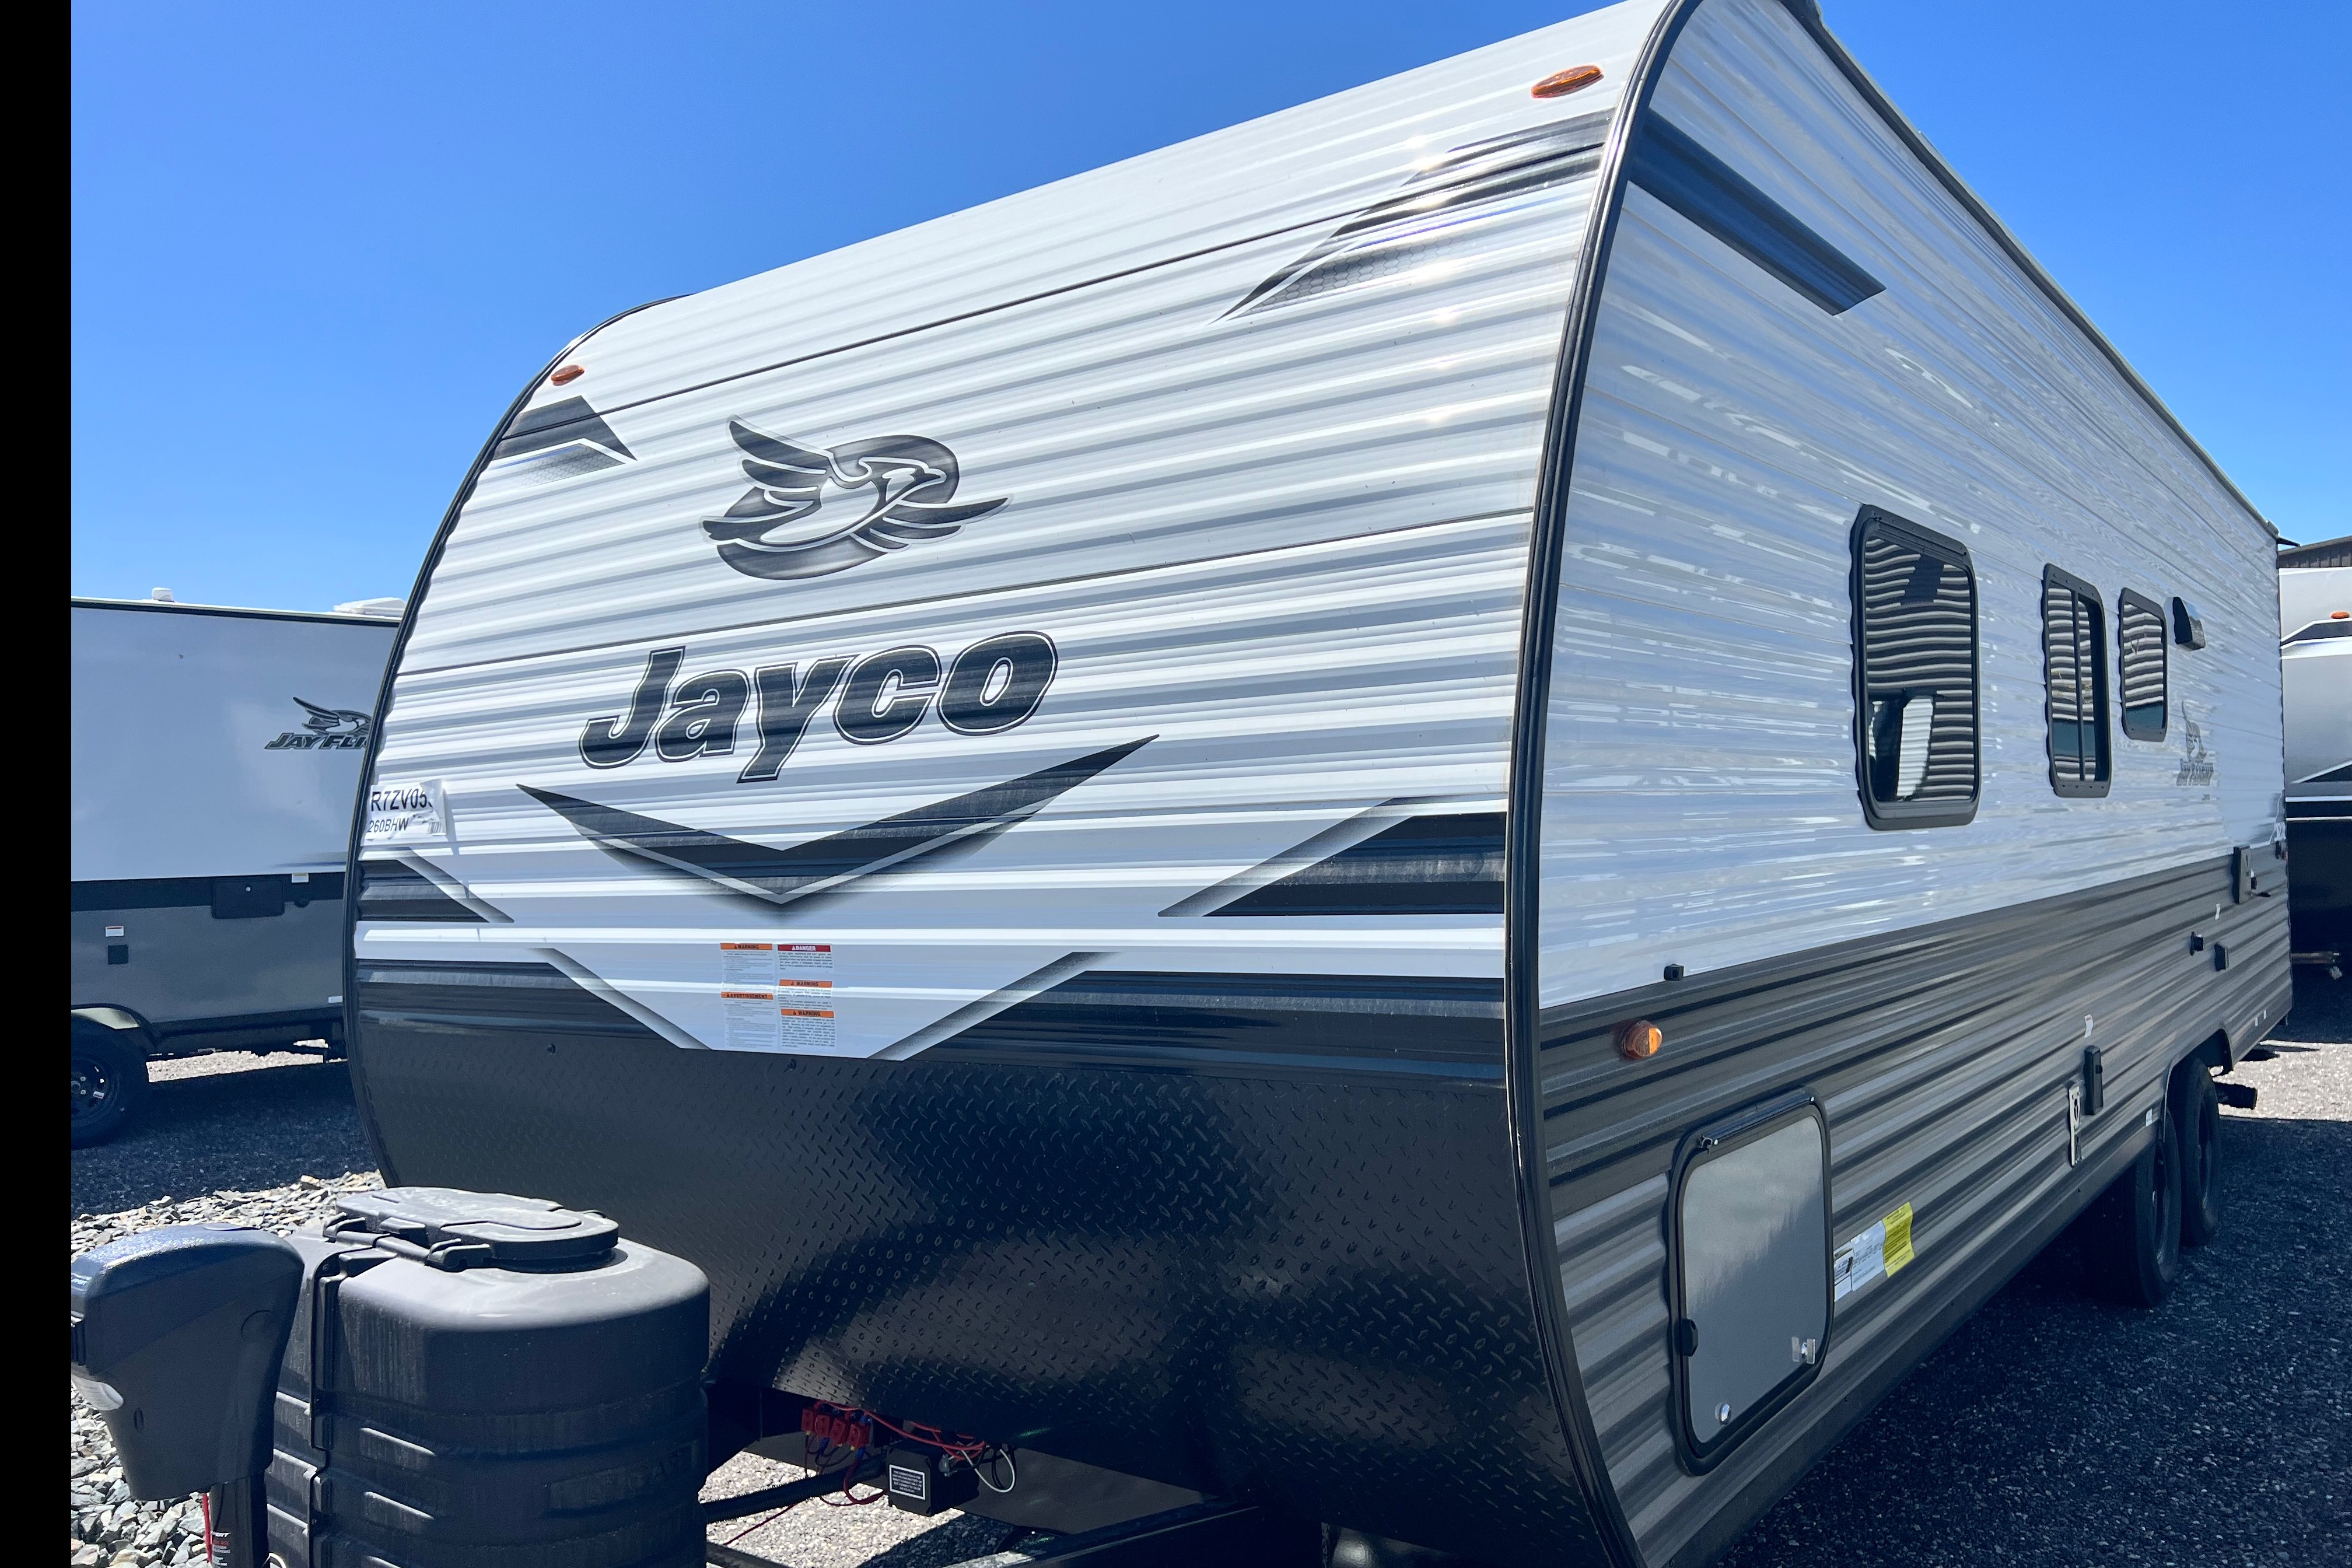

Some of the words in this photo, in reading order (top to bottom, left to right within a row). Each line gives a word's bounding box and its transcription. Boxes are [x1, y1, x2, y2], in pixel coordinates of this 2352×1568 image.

[579, 630, 1059, 783] Jayco
[264, 733, 321, 750] JAY
[318, 734, 367, 750] FLI
[367, 817, 409, 833] 260BHW
